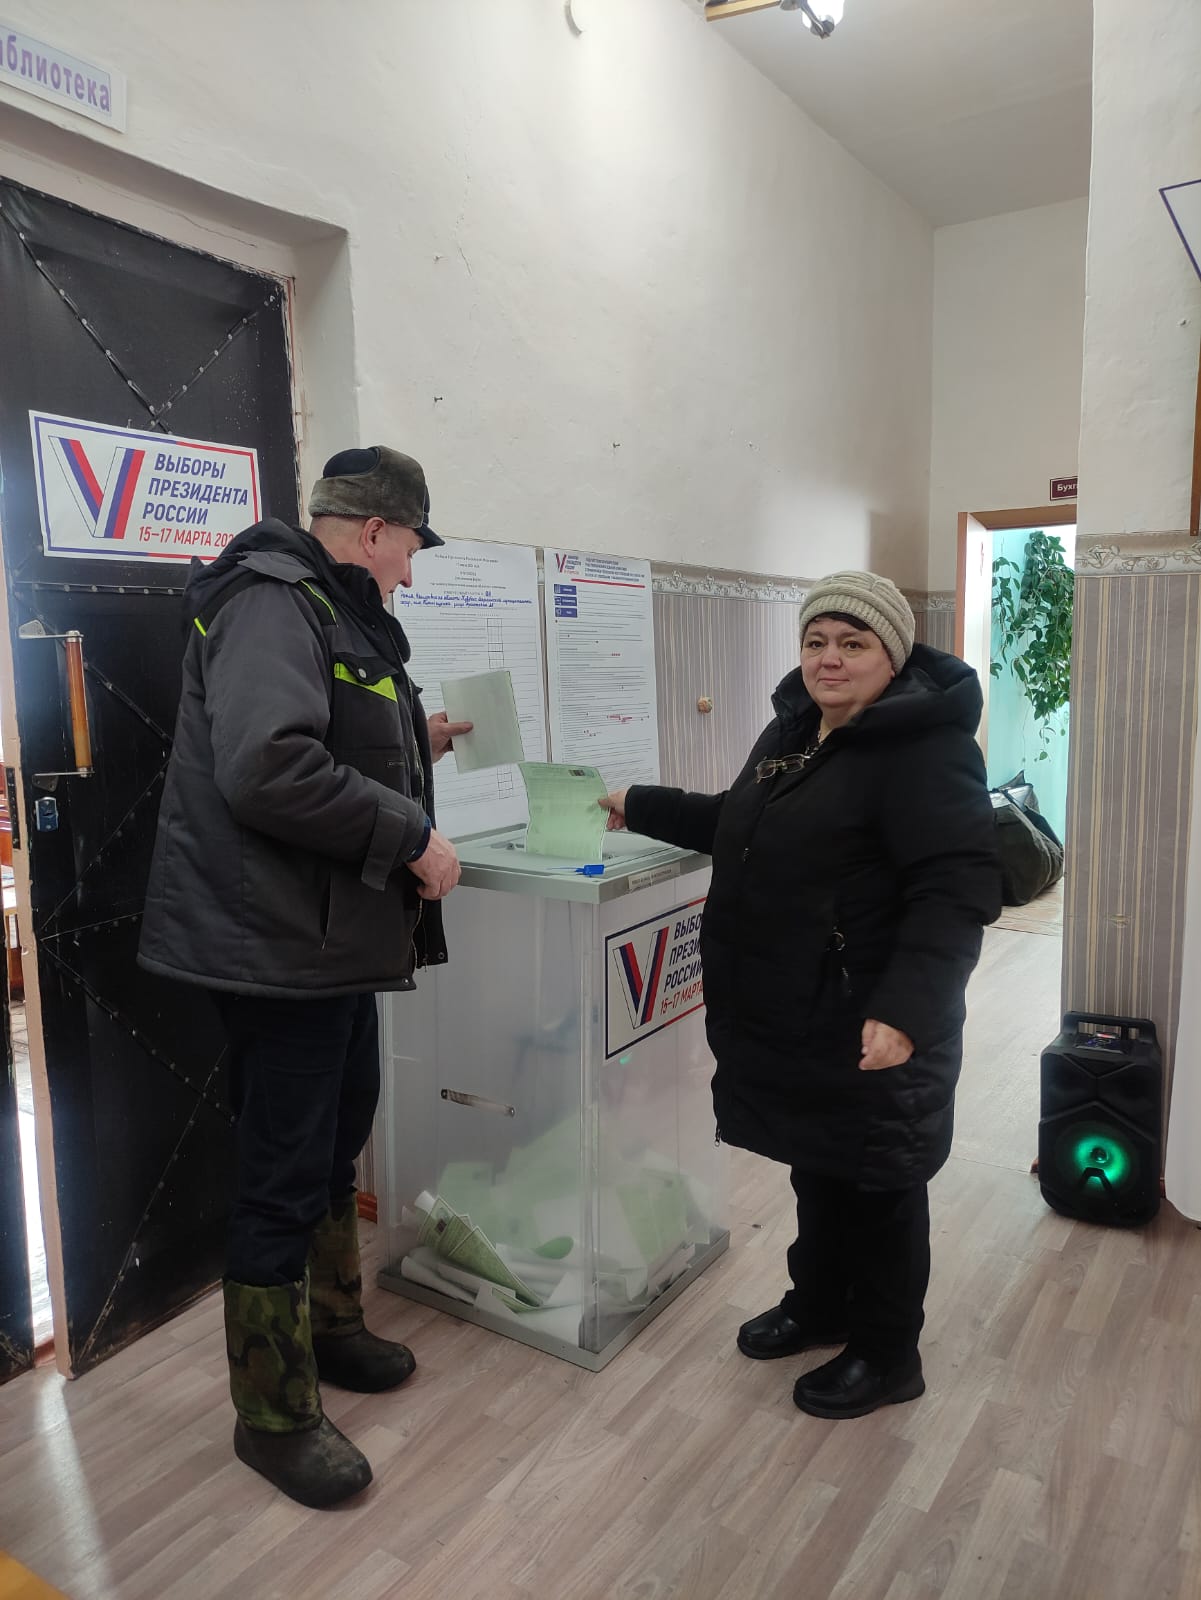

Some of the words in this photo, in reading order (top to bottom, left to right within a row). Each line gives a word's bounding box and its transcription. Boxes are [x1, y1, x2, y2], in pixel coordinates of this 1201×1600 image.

[154, 453, 226, 479] ВЫБОРЫ
[148, 478, 249, 506] ПРЕЗИДЕНТА
[1057, 483, 1077, 492] Бухг
[142, 502, 209, 525] РОССИИ
[173, 529, 212, 547] МАРТА
